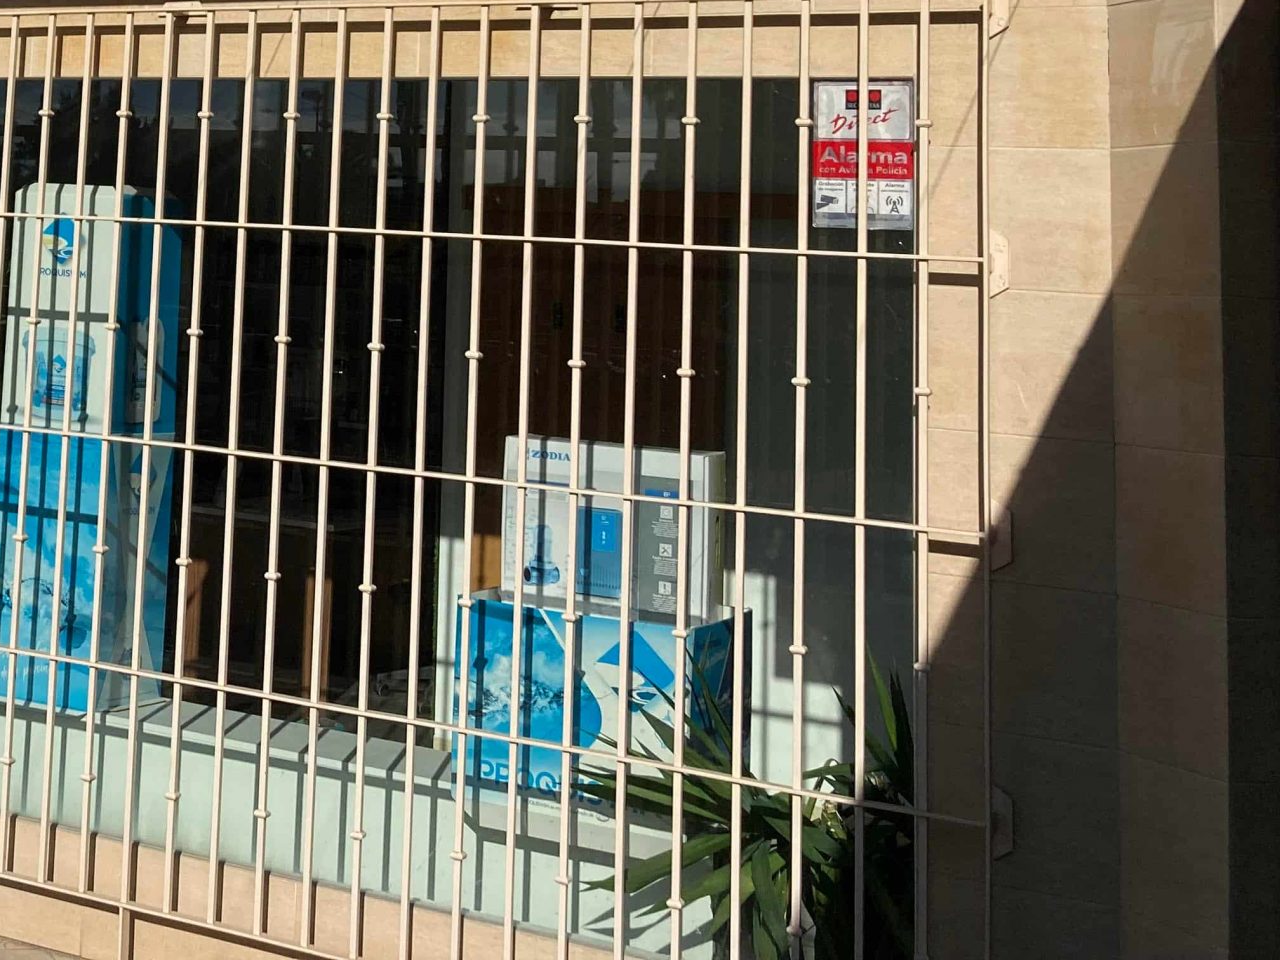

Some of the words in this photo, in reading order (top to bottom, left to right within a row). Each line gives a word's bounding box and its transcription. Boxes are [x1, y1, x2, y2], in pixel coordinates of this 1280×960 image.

[830, 106, 899, 135] Dict
[820, 144, 908, 165] Alama
[531, 449, 571, 461] ZODIA
